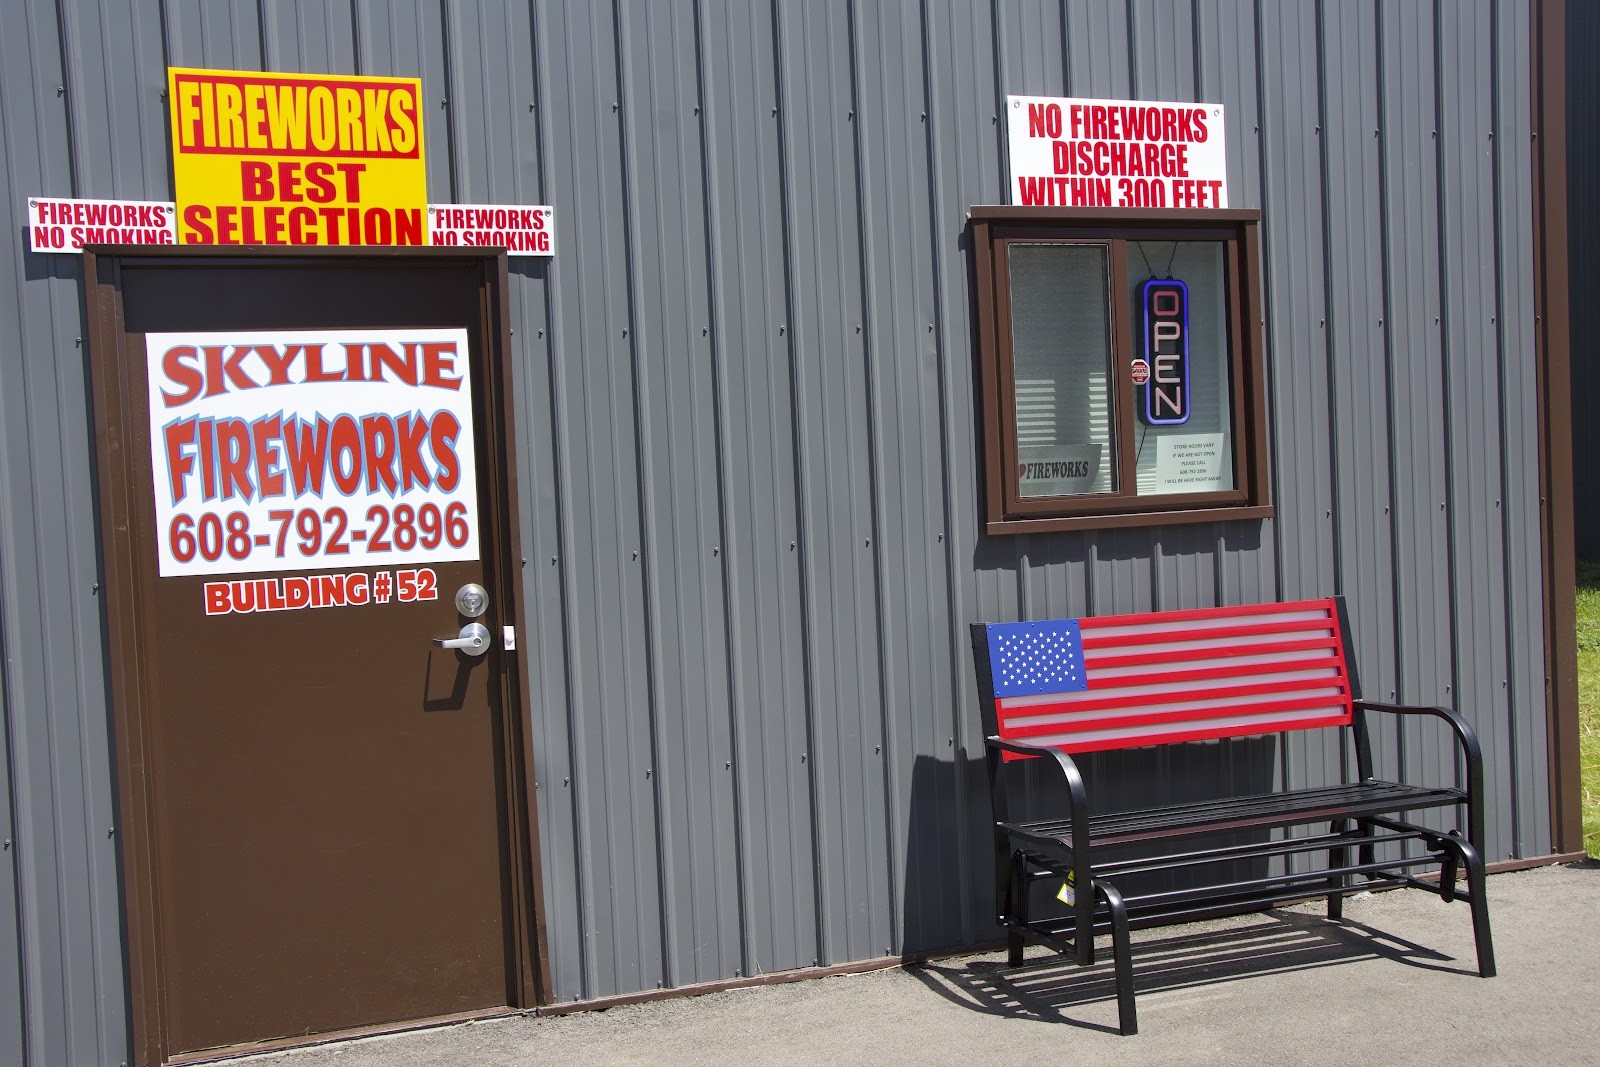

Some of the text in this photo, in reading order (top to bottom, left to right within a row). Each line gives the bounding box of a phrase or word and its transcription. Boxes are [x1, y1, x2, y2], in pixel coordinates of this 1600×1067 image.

[178, 81, 416, 154] FIREWORKS
[1028, 103, 1208, 143] NO FIREWORKS
[1052, 141, 1189, 178] DISCHARGE
[240, 160, 367, 204] BEST
[1018, 176, 1222, 209] WITHIN 300 FEET
[38, 202, 167, 228] FIREWORKS
[183, 204, 422, 246] SELECTION
[436, 208, 544, 230] FIREWORKS
[34, 226, 173, 249] NO SMOKING
[432, 230, 550, 252] NO SMOKING
[1153, 290, 1182, 417] OPEN
[159, 340, 465, 409] SKYLINE
[161, 408, 462, 508] FIREWORKS
[1026, 461, 1089, 479] FIREWORKS
[168, 501, 469, 563] 608-792-2896
[203, 568, 438, 616] BUILDING # 52
